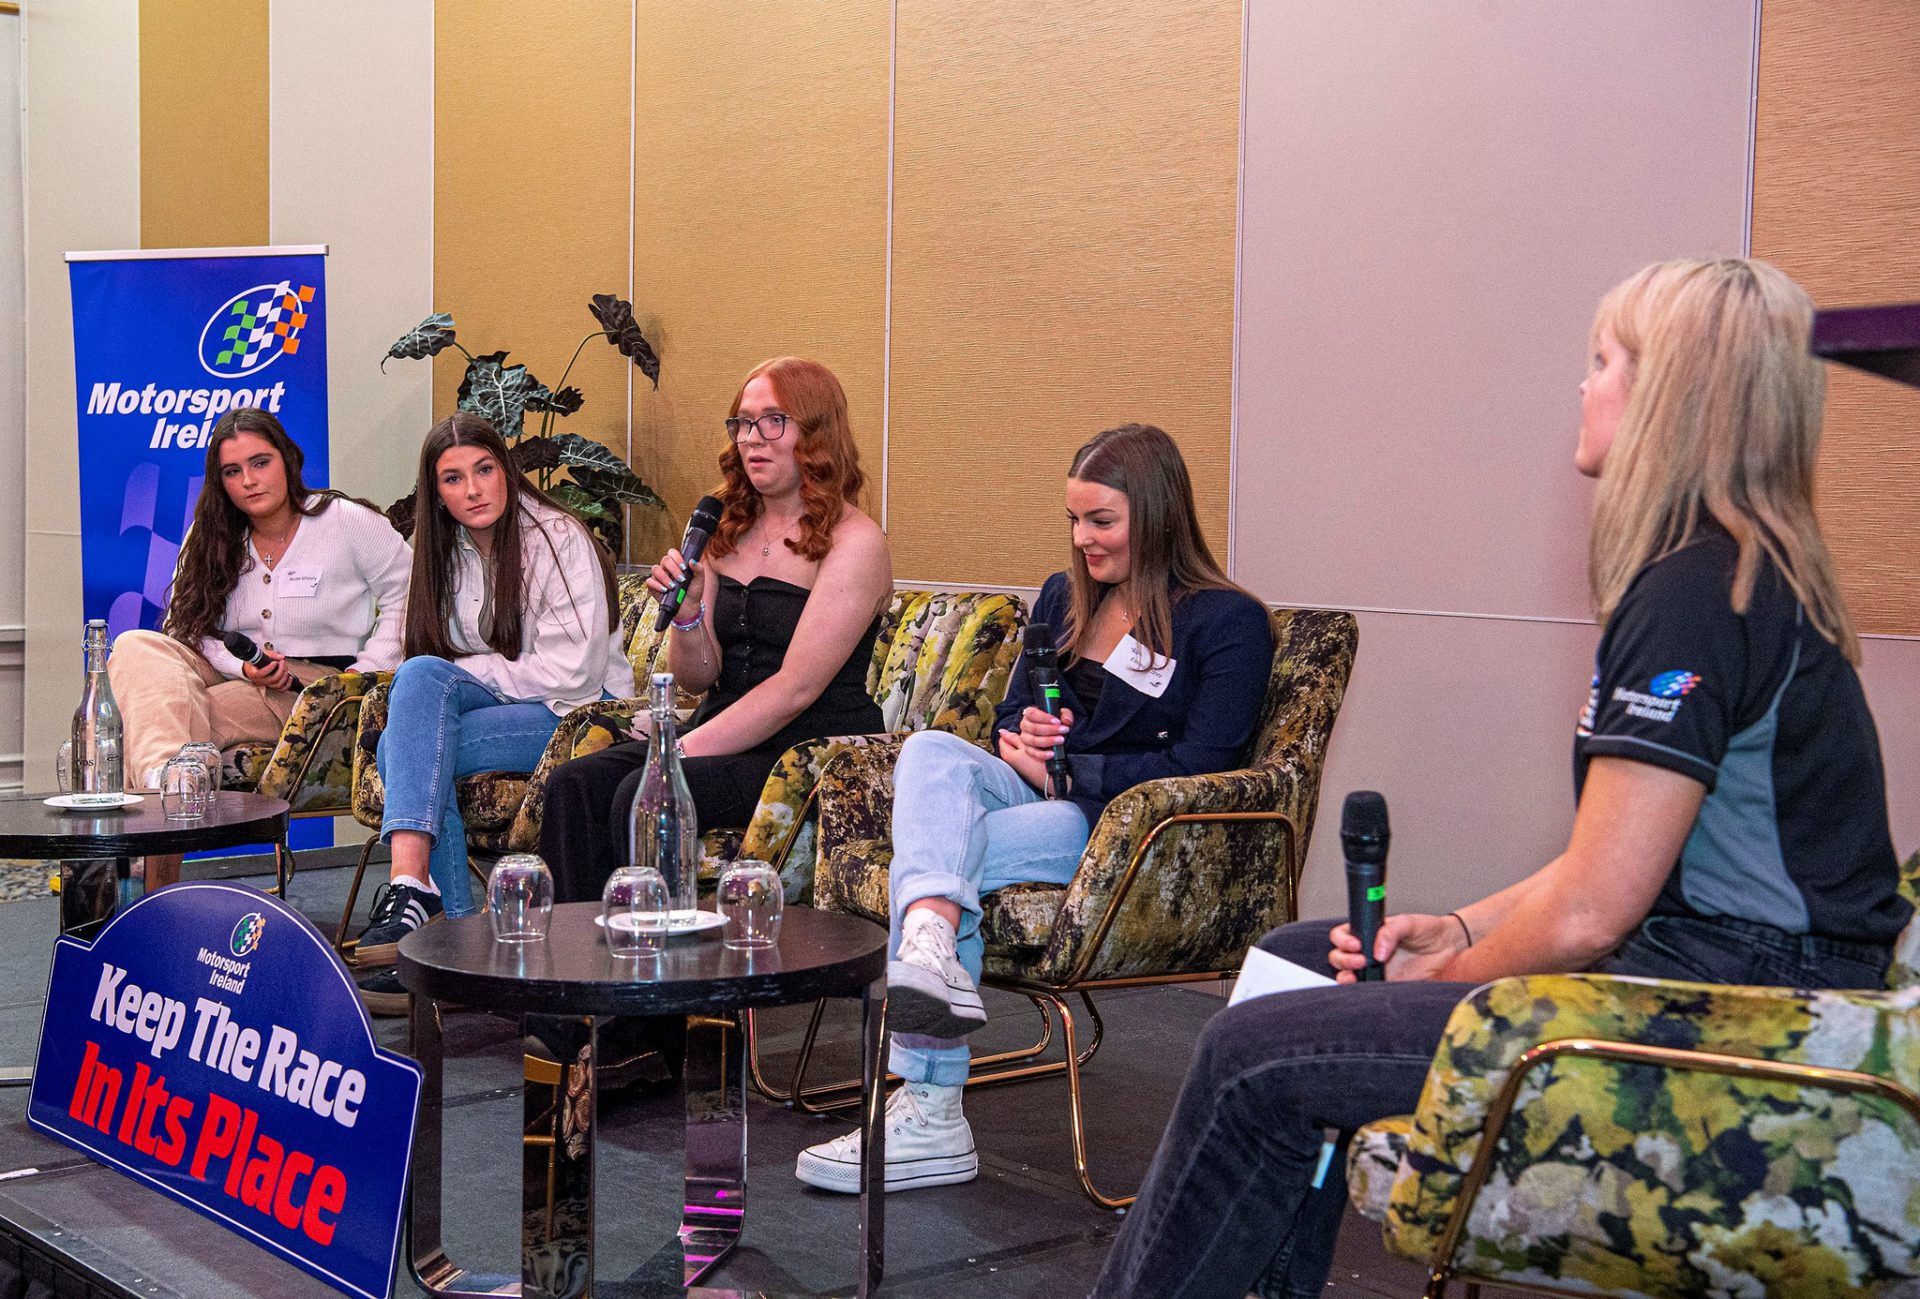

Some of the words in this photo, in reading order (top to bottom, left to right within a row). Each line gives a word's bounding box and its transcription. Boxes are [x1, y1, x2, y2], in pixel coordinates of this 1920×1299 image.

[86, 381, 286, 420] Motorsport
[149, 417, 216, 449] Irel
[197, 947, 251, 978] Motorsport
[209, 969, 246, 995] Ireland
[90, 962, 186, 1059] Keep
[188, 997, 261, 1083] The
[257, 1024, 367, 1128] Race
[68, 1040, 123, 1135] In
[117, 1061, 194, 1167] Its
[189, 1092, 348, 1247] Place
